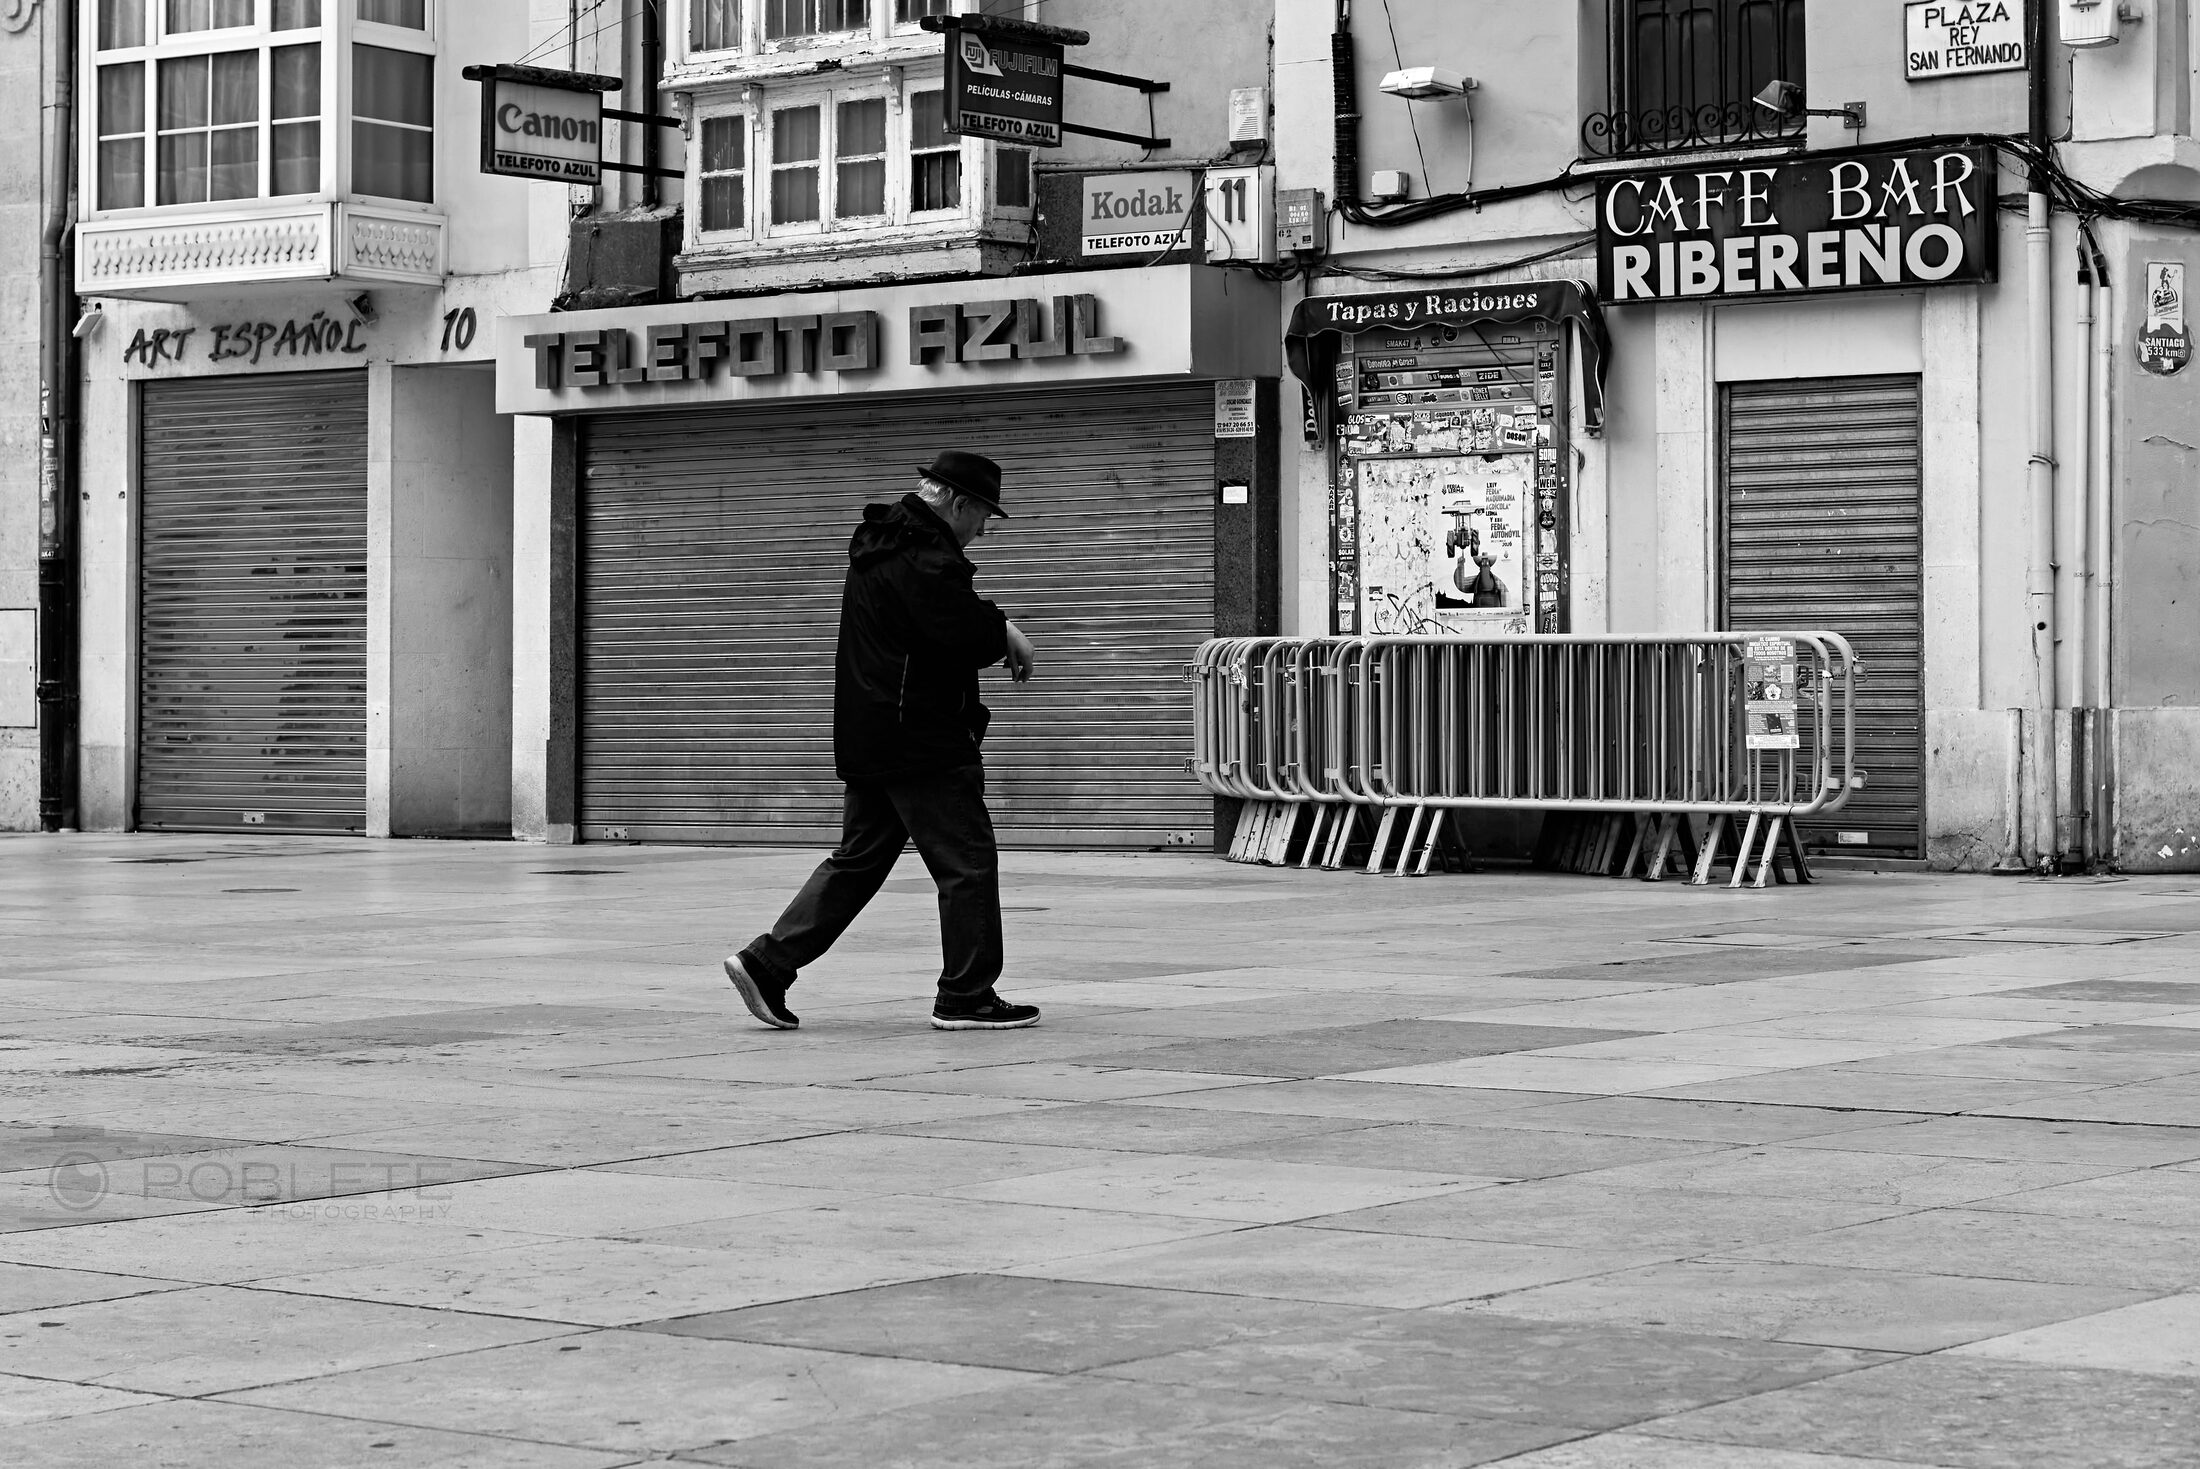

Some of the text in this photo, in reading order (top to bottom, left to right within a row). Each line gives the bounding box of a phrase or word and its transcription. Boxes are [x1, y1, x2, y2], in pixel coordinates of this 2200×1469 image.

[1925, 1, 2010, 28] PLAZA
[1950, 26, 1979, 46] REY
[989, 49, 1058, 77] FUJIFILM
[1910, 43, 2021, 71] SAN FERNANDO
[497, 103, 597, 144] Canon
[962, 113, 1056, 139] TELEFOTO AZUL
[497, 154, 595, 177] TELEFOTO AZUL
[1091, 187, 1183, 220] Kodak
[1219, 179, 1246, 223] 11
[1605, 152, 1976, 236] CAFE BAR
[1088, 232, 1186, 249] TELEFOTO AZUL
[1326, 291, 1538, 324] Tapas y Raciones
[124, 311, 367, 369] ART ESPAÑOL
[441, 307, 477, 351] 10
[524, 293, 1124, 390] TELEFOTO AZUL
[2145, 338, 2185, 348] SANTIAGO
[2148, 347, 2178, 357] 533 km
